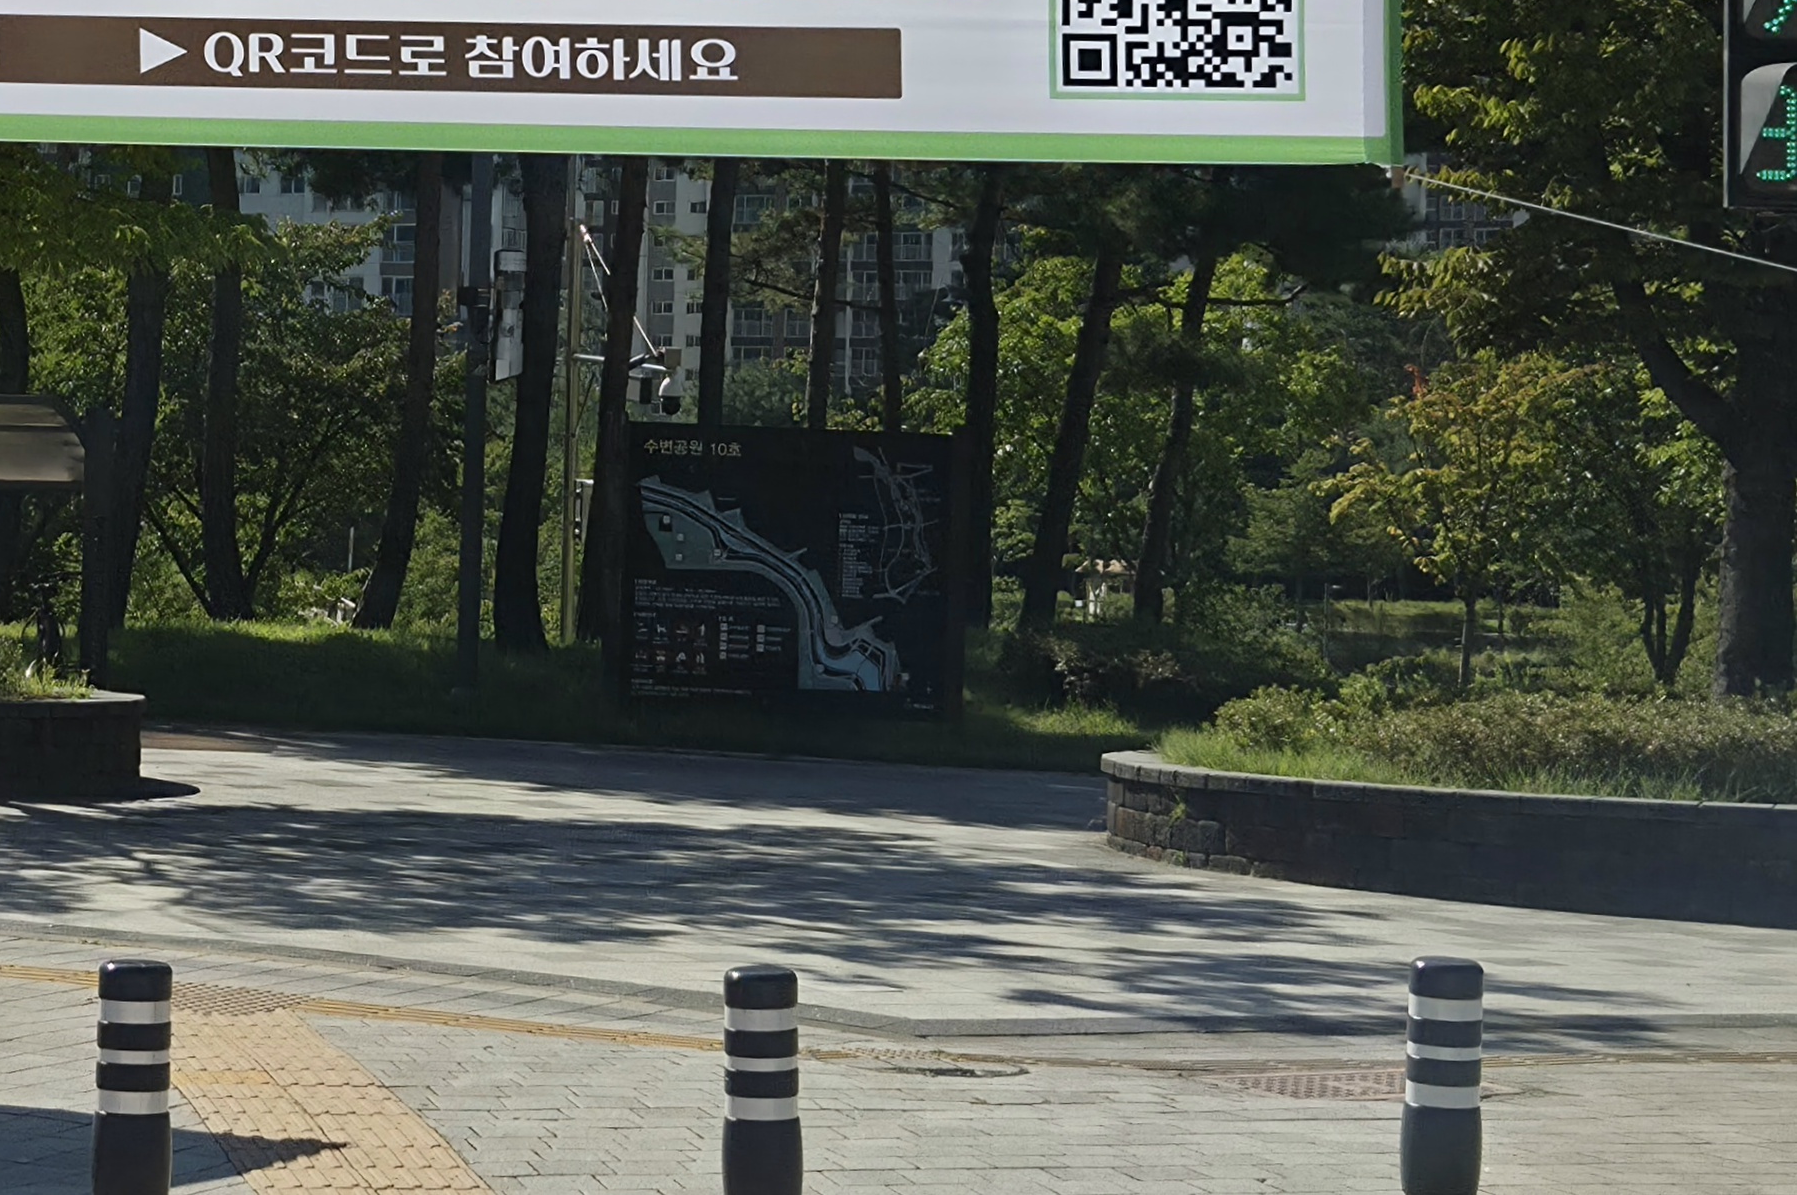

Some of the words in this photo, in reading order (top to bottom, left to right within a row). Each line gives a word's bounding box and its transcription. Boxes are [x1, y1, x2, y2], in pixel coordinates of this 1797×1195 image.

[203, 31, 447, 77] QR코드로
[464, 34, 739, 82] 참여하세요
[644, 439, 703, 456] 수변공원
